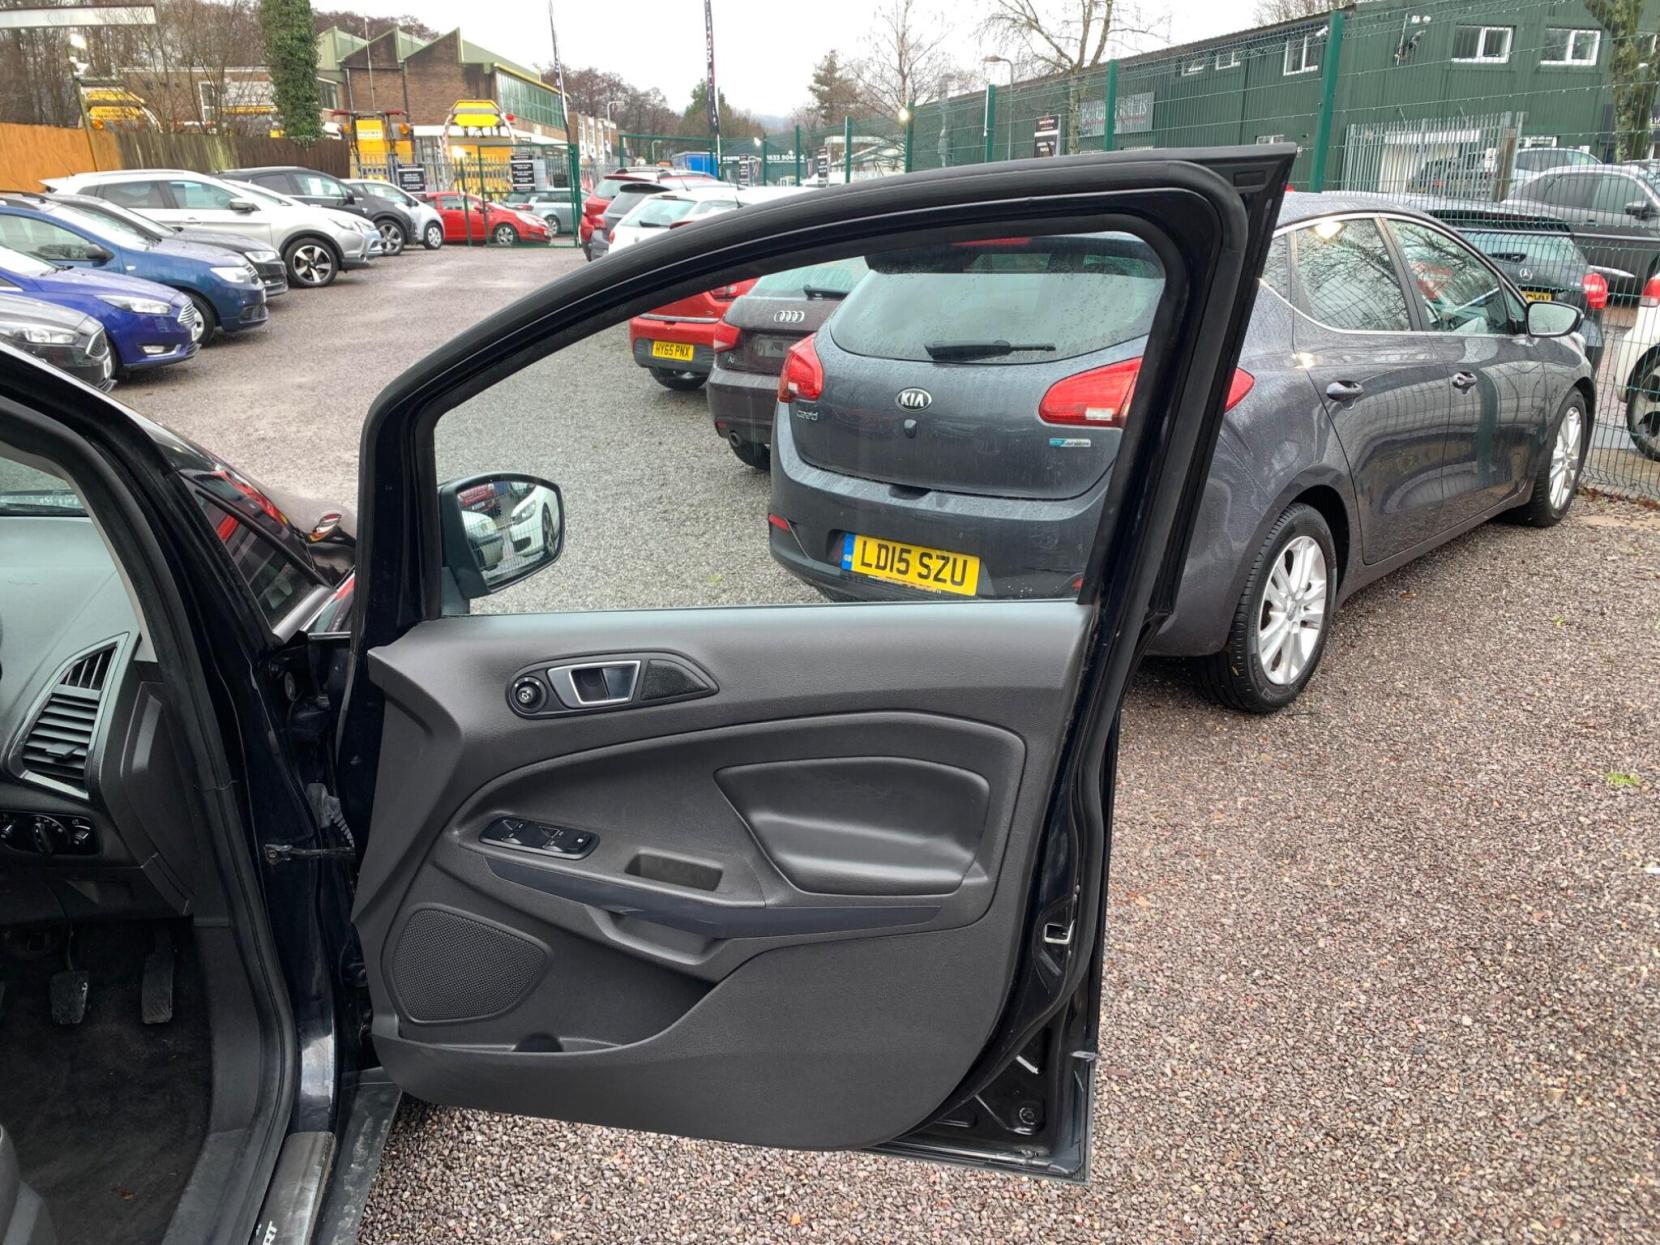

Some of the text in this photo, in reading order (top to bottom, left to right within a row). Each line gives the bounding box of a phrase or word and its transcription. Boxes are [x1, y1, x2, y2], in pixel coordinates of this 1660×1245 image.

[900, 392, 925, 407] KIA
[860, 540, 912, 576] LD15
[917, 552, 968, 587] SZU
